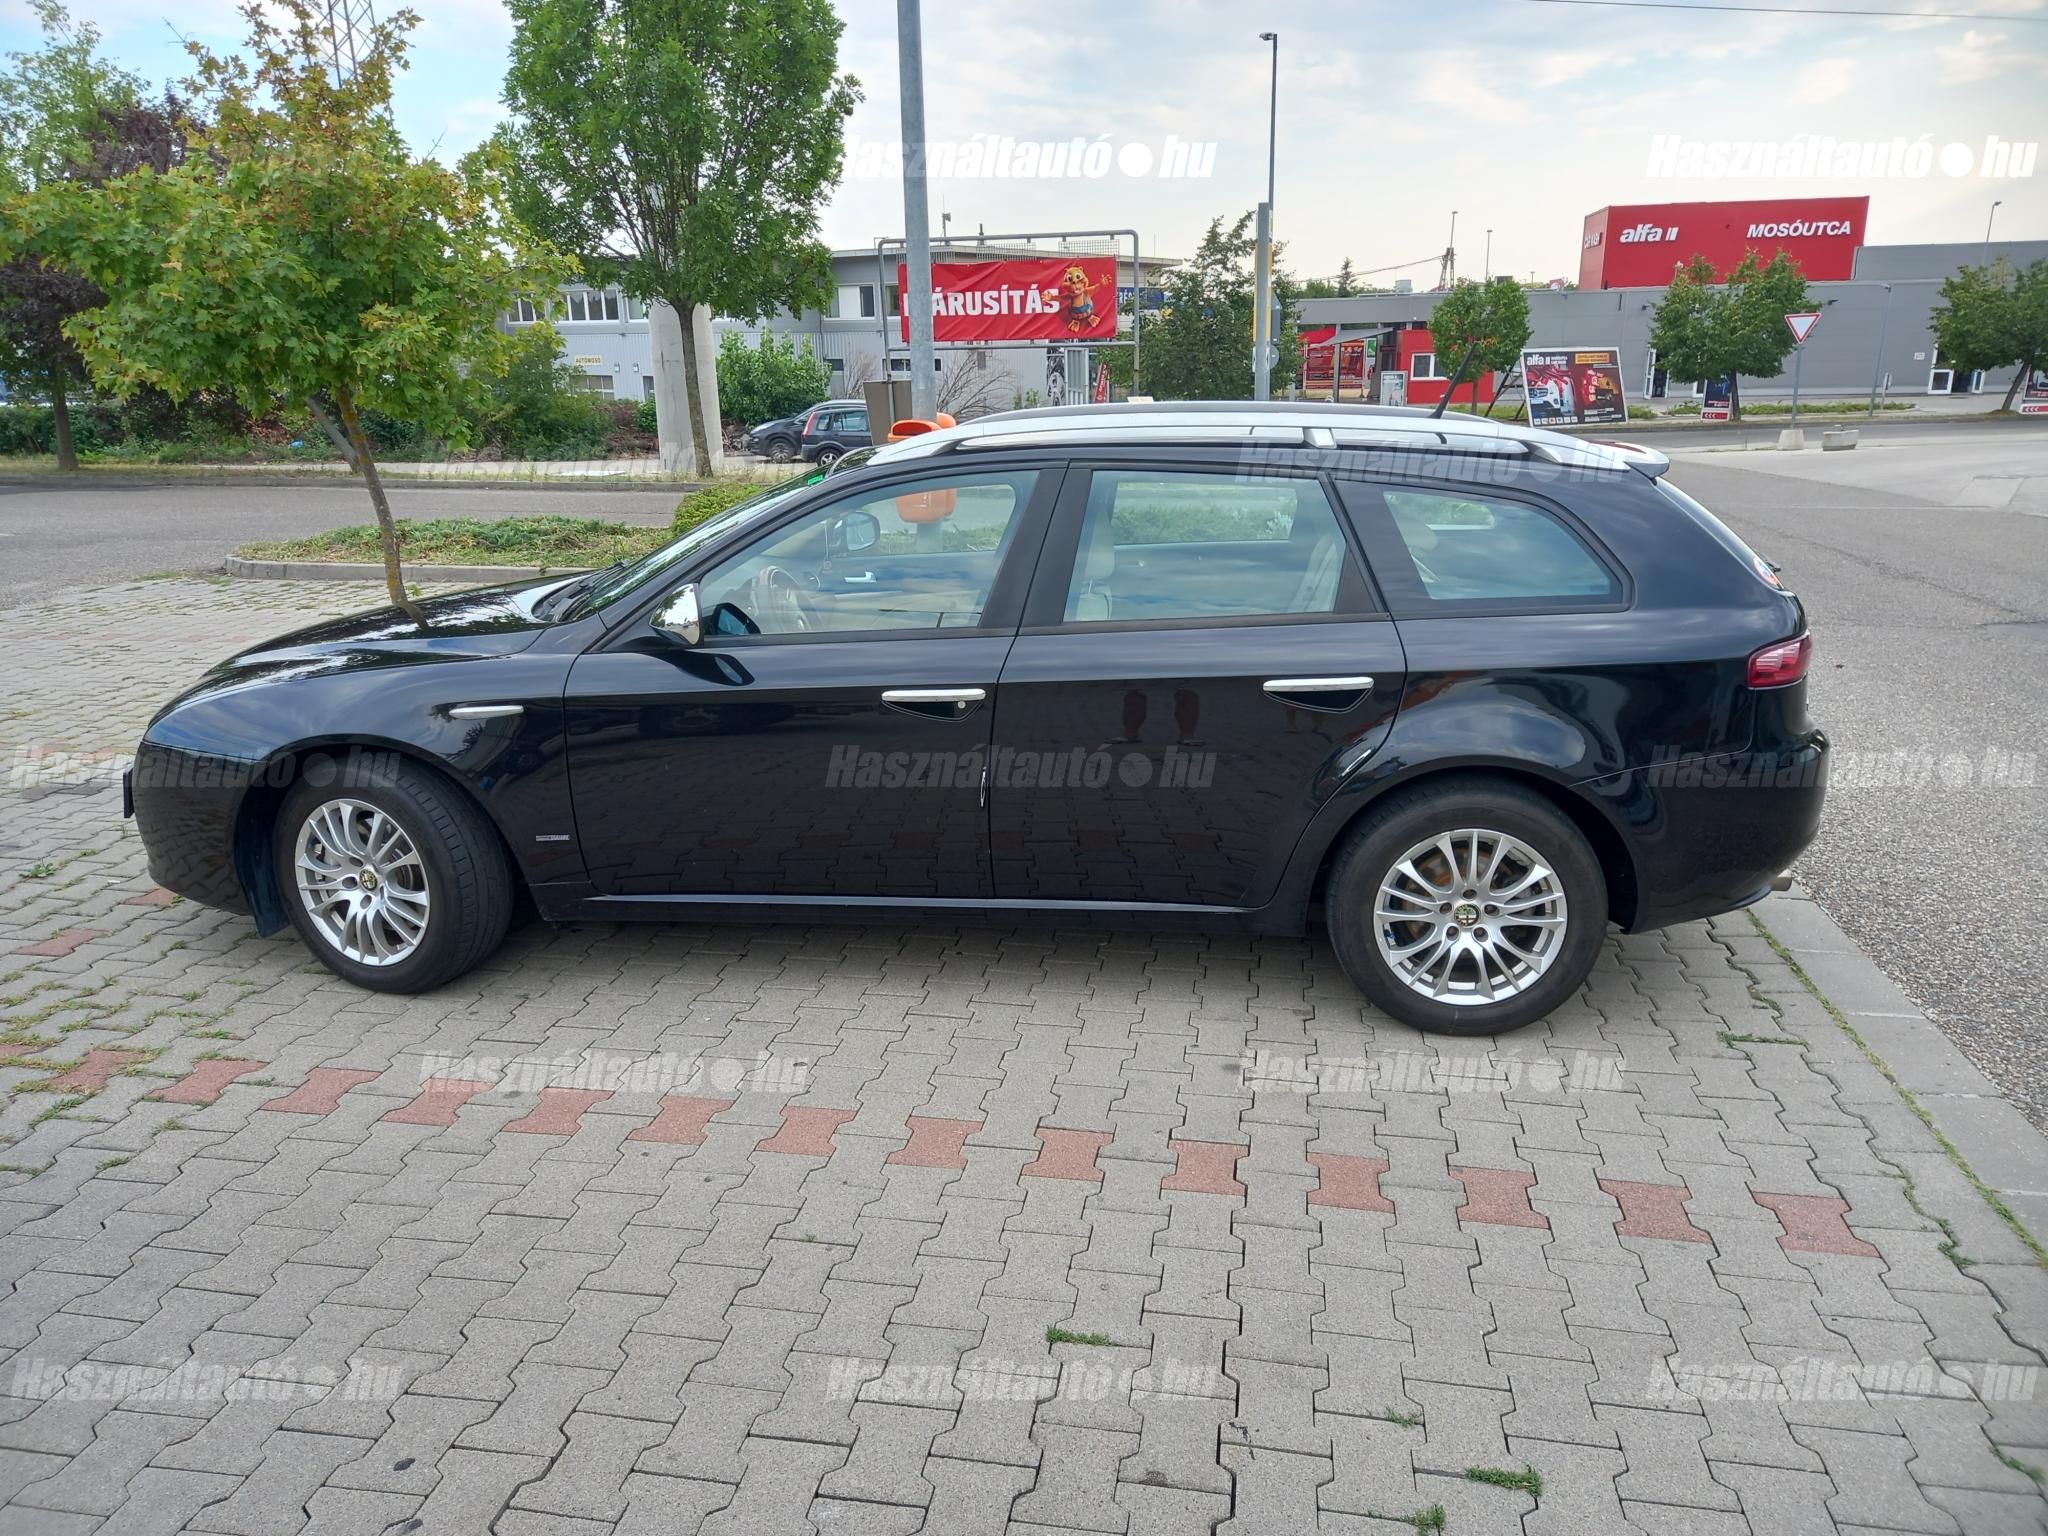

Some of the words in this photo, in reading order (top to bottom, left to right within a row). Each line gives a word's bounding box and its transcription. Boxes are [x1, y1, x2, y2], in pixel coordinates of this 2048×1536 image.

[1620, 224, 1663, 243] alfa
[1747, 219, 1851, 238] MOSÓUTCA
[903, 284, 1060, 316] ÁRUSÍTÁS
[1526, 354, 1545, 365] alfa
